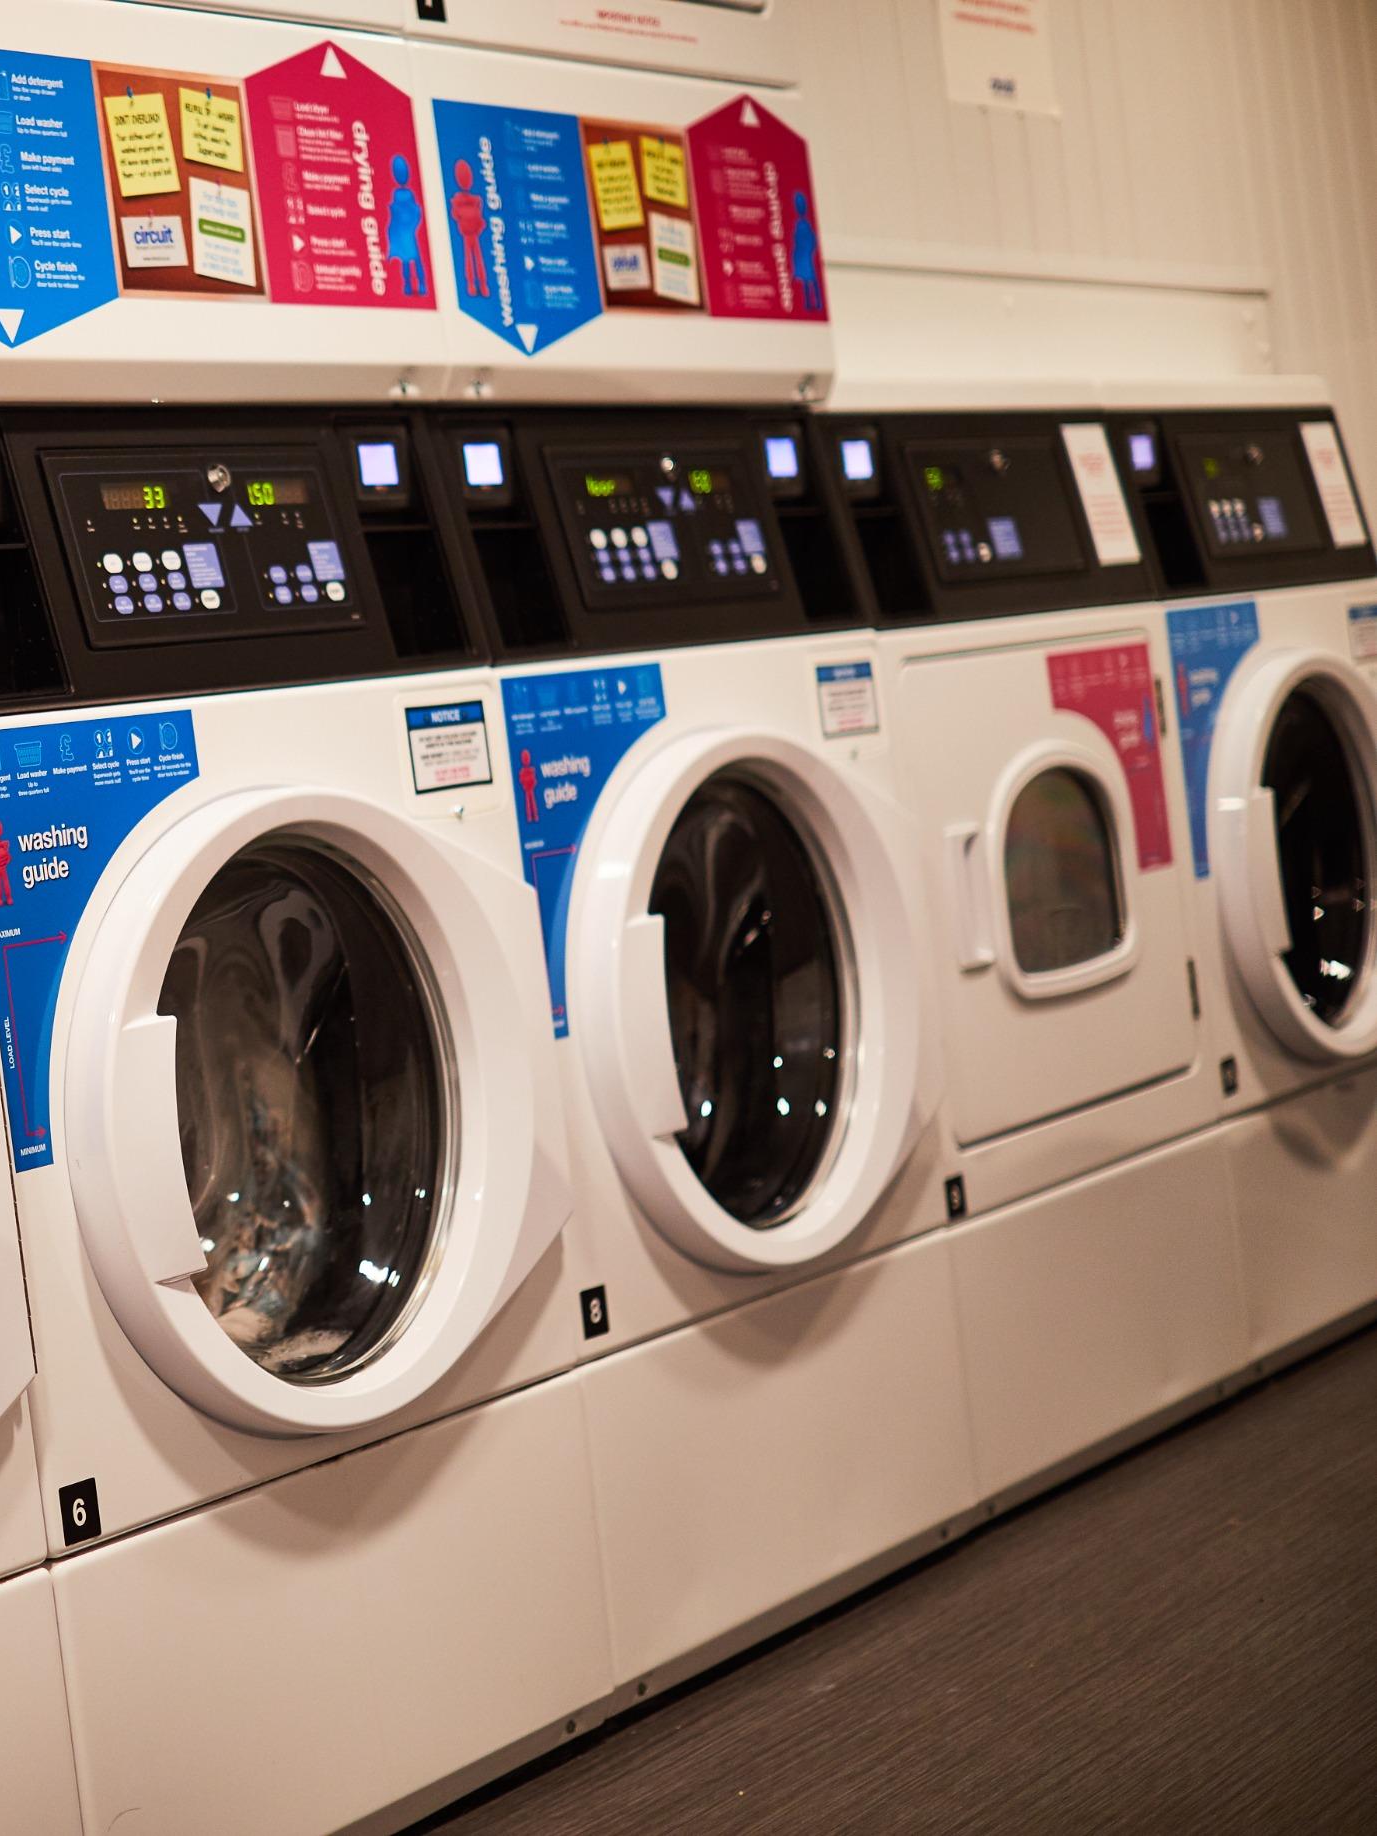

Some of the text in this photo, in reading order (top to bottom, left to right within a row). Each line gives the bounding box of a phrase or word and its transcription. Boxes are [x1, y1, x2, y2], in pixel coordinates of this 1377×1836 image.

[352, 120, 386, 296] drying guide
[133, 225, 173, 244] circuit
[479, 136, 514, 327] washing guide
[143, 486, 165, 509] 33
[431, 709, 460, 722] NOTICE
[67, 765, 87, 774] payment
[92, 761, 120, 770] Select cycle
[159, 755, 171, 763] Cycle
[541, 755, 590, 778] washing
[544, 782, 577, 809] guide
[18, 824, 88, 888] washing guide
[20, 1144, 46, 1157] MINIMUM
[590, 1298, 602, 1323] 8
[73, 1498, 86, 1526] 6
